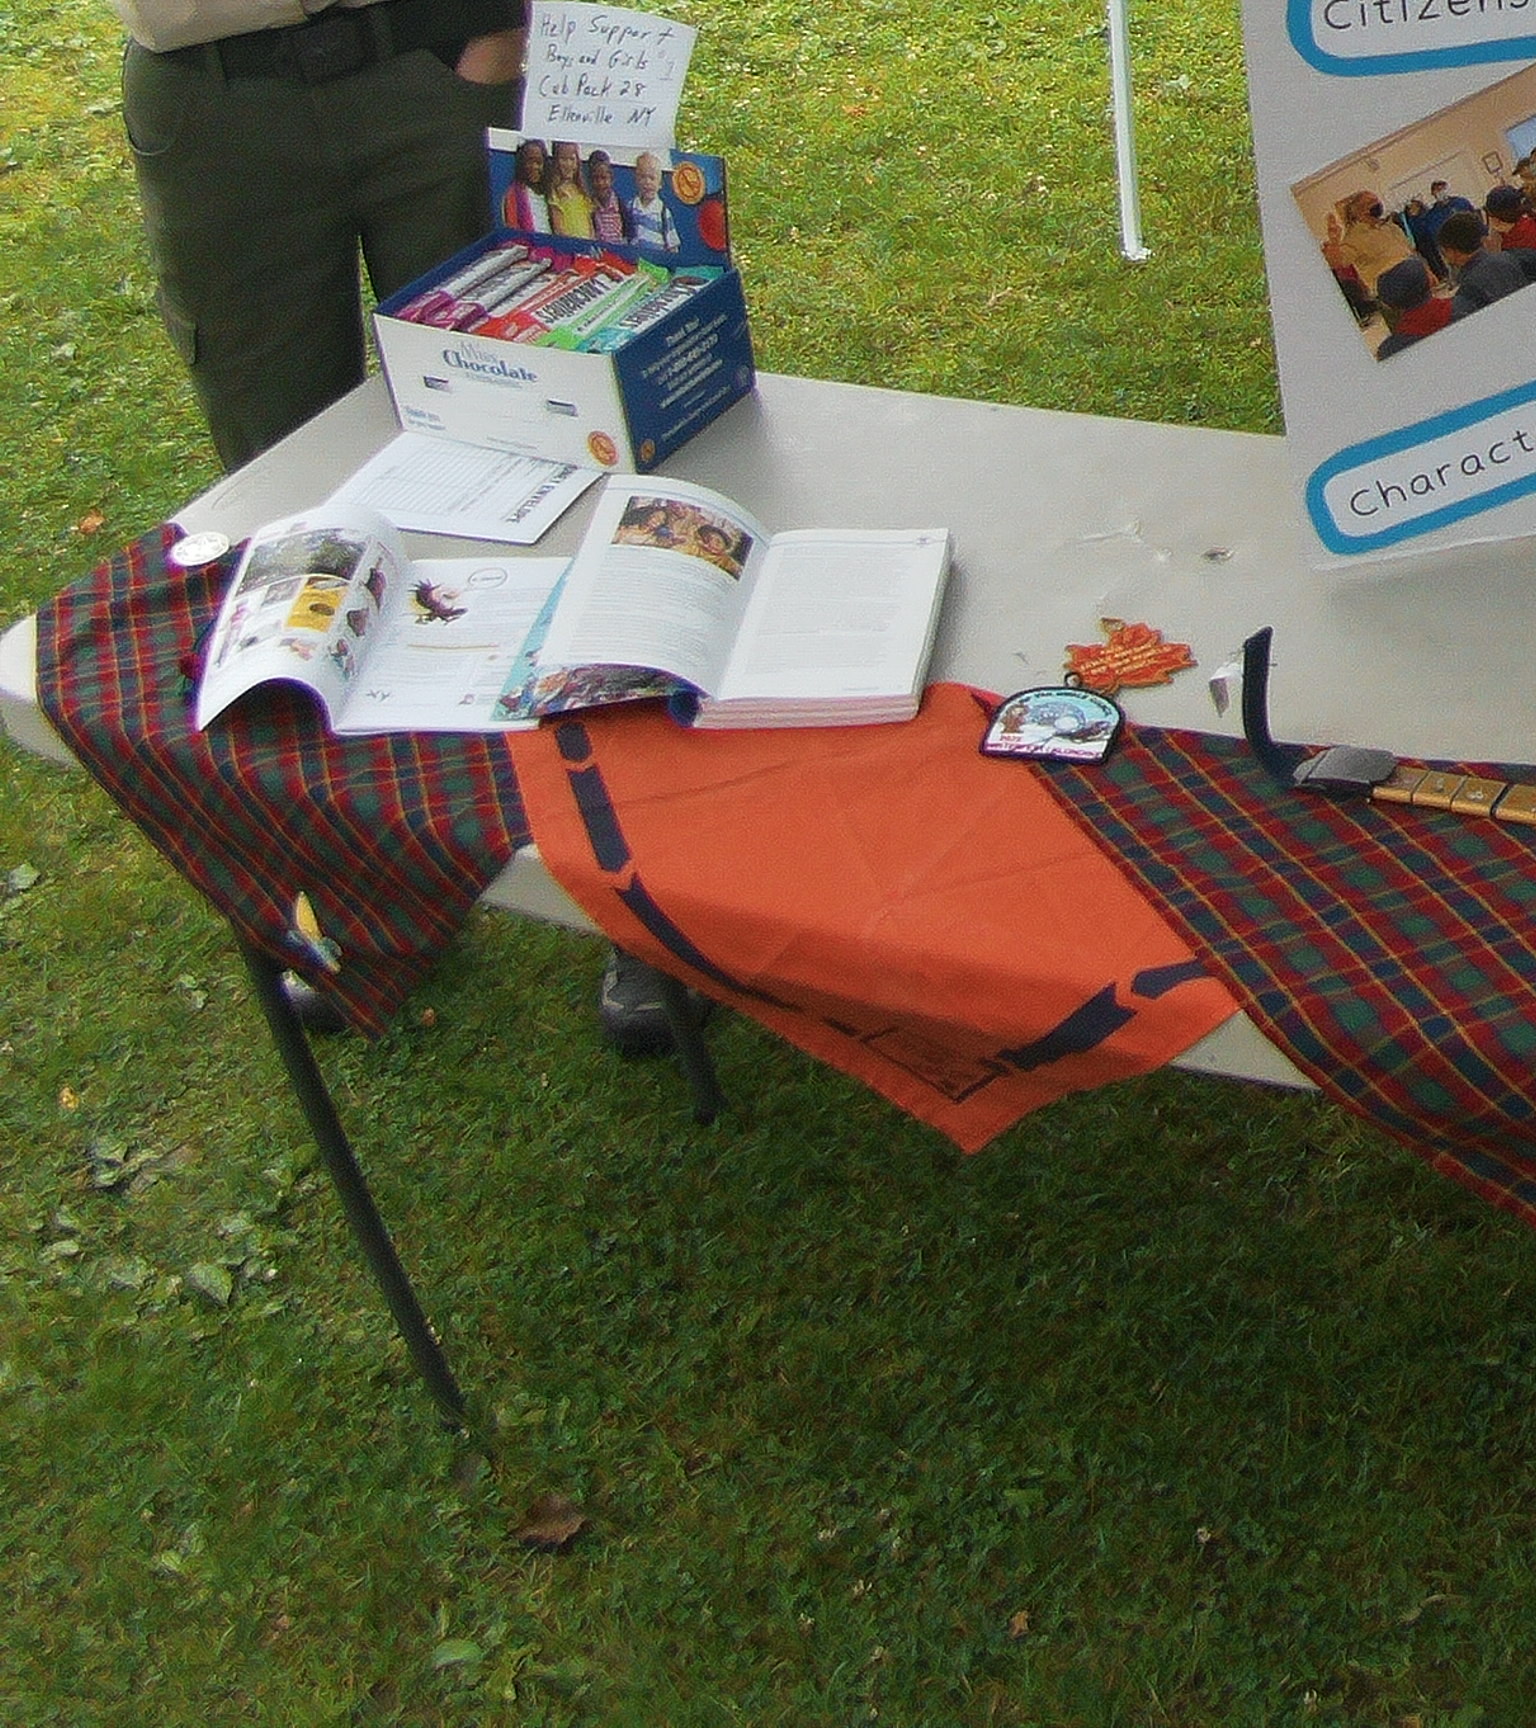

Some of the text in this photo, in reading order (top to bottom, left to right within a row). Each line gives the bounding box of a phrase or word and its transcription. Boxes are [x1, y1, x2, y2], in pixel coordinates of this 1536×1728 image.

[541, 13, 676, 45] Help Support
[618, 79, 648, 98] 28
[626, 106, 657, 127] NY
[443, 348, 539, 382] Chocolate
